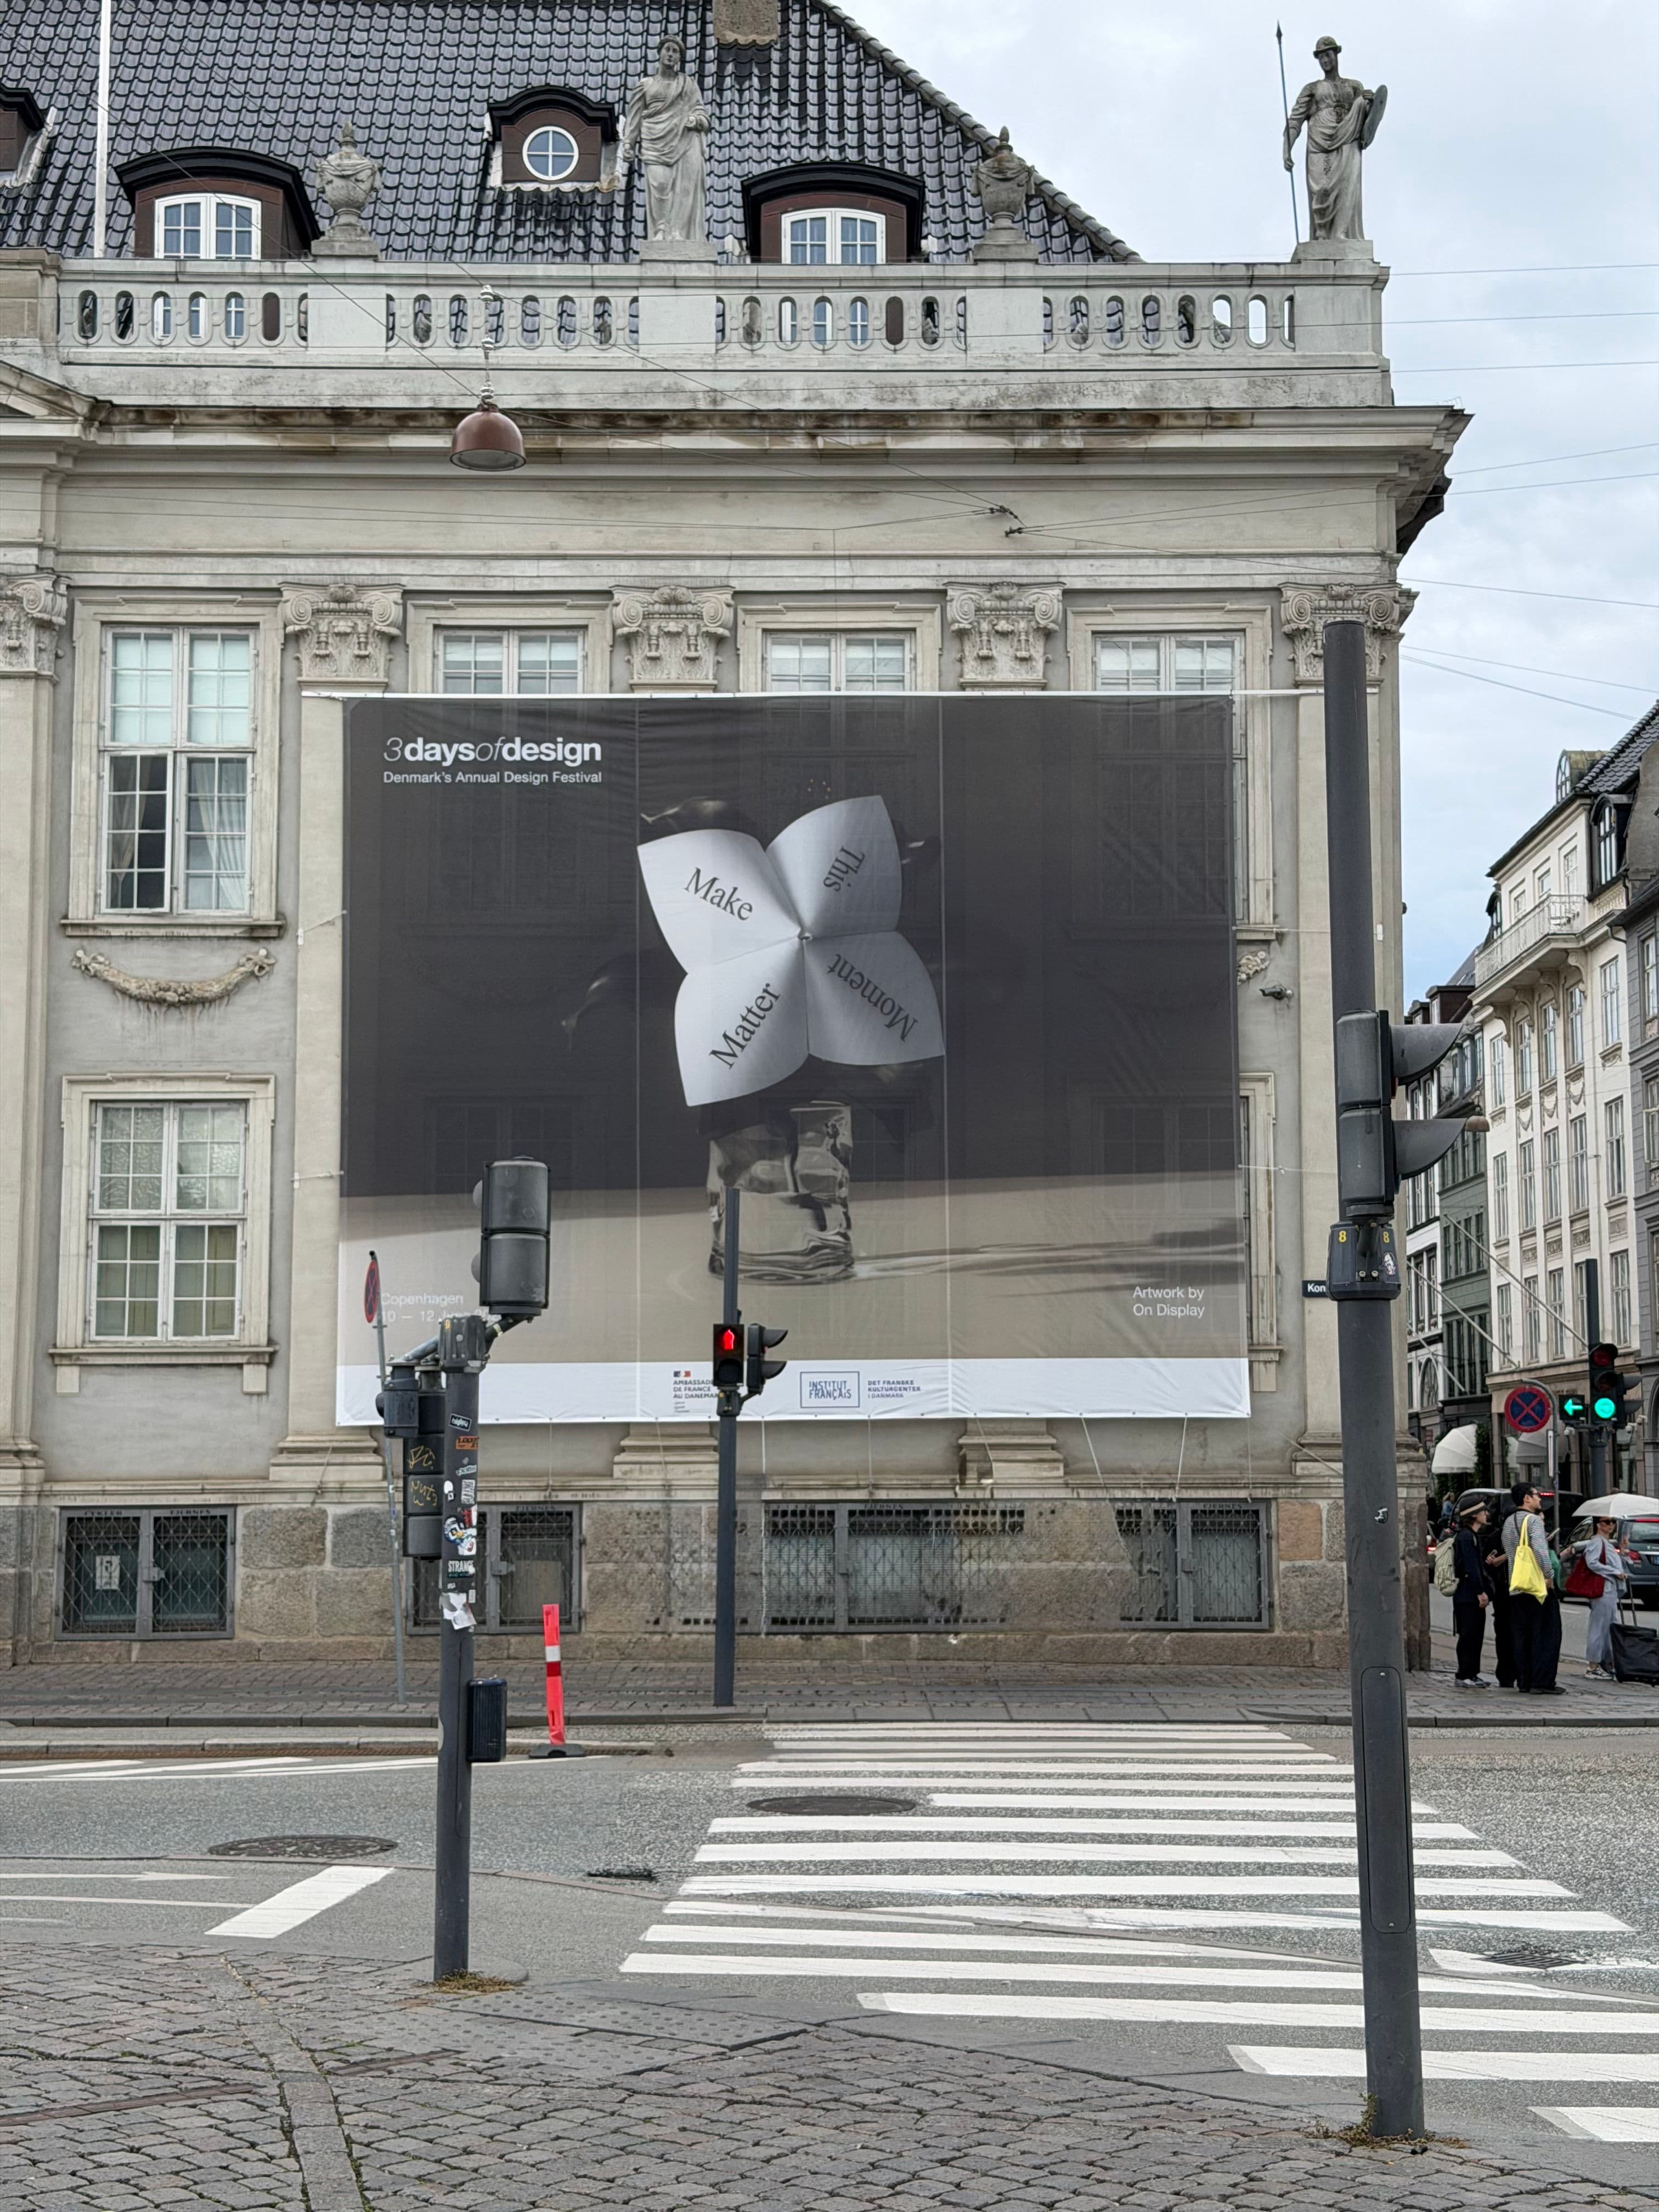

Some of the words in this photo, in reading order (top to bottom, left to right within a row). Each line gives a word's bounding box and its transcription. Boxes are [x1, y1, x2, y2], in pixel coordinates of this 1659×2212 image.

[383, 736, 602, 767] 3daysofdesign
[383, 771, 452, 783] Denmark’s
[455, 771, 500, 783] Annual
[504, 771, 549, 786] Design
[552, 771, 602, 783] Festival
[823, 845, 866, 893] This
[684, 867, 753, 922] Make
[827, 953, 919, 1043] Moment
[708, 983, 781, 1070] Matter
[1339, 1230, 1347, 1243] 8
[1383, 1231, 1390, 1243] 8
[380, 1293, 463, 1307] Copenhagen
[1132, 1286, 1184, 1299] Artwork
[1188, 1286, 1204, 1301] by
[421, 1310, 435, 1322] 12
[1133, 1303, 1153, 1316] On
[1156, 1303, 1205, 1318] Display
[809, 1380, 847, 1391] INSTITUT
